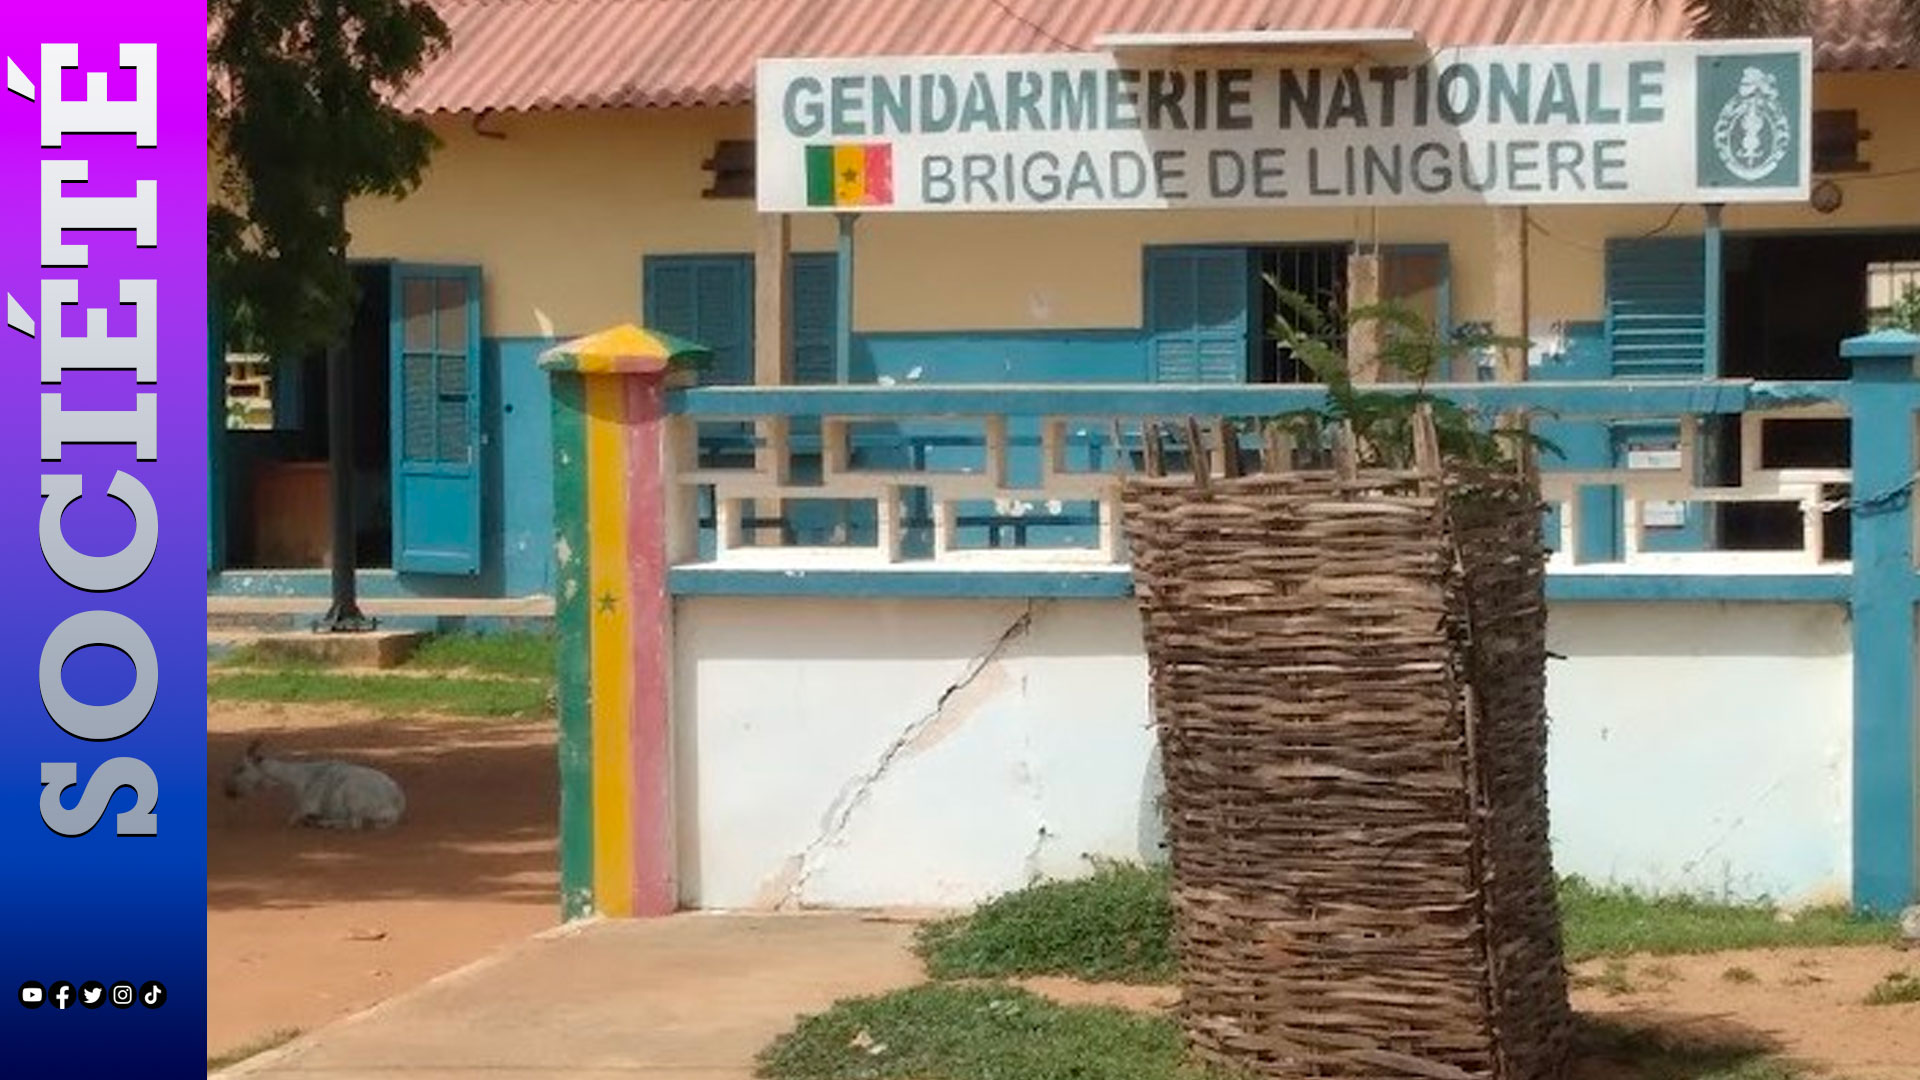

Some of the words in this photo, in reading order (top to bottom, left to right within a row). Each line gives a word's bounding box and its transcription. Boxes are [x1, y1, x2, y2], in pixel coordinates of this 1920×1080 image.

[782, 67, 1254, 138] GENDARMERIE
[1278, 60, 1666, 130] NATIONALE
[920, 148, 1189, 204] BRIGADE
[1208, 147, 1288, 199] DE
[1308, 138, 1629, 196] LINGUERE
